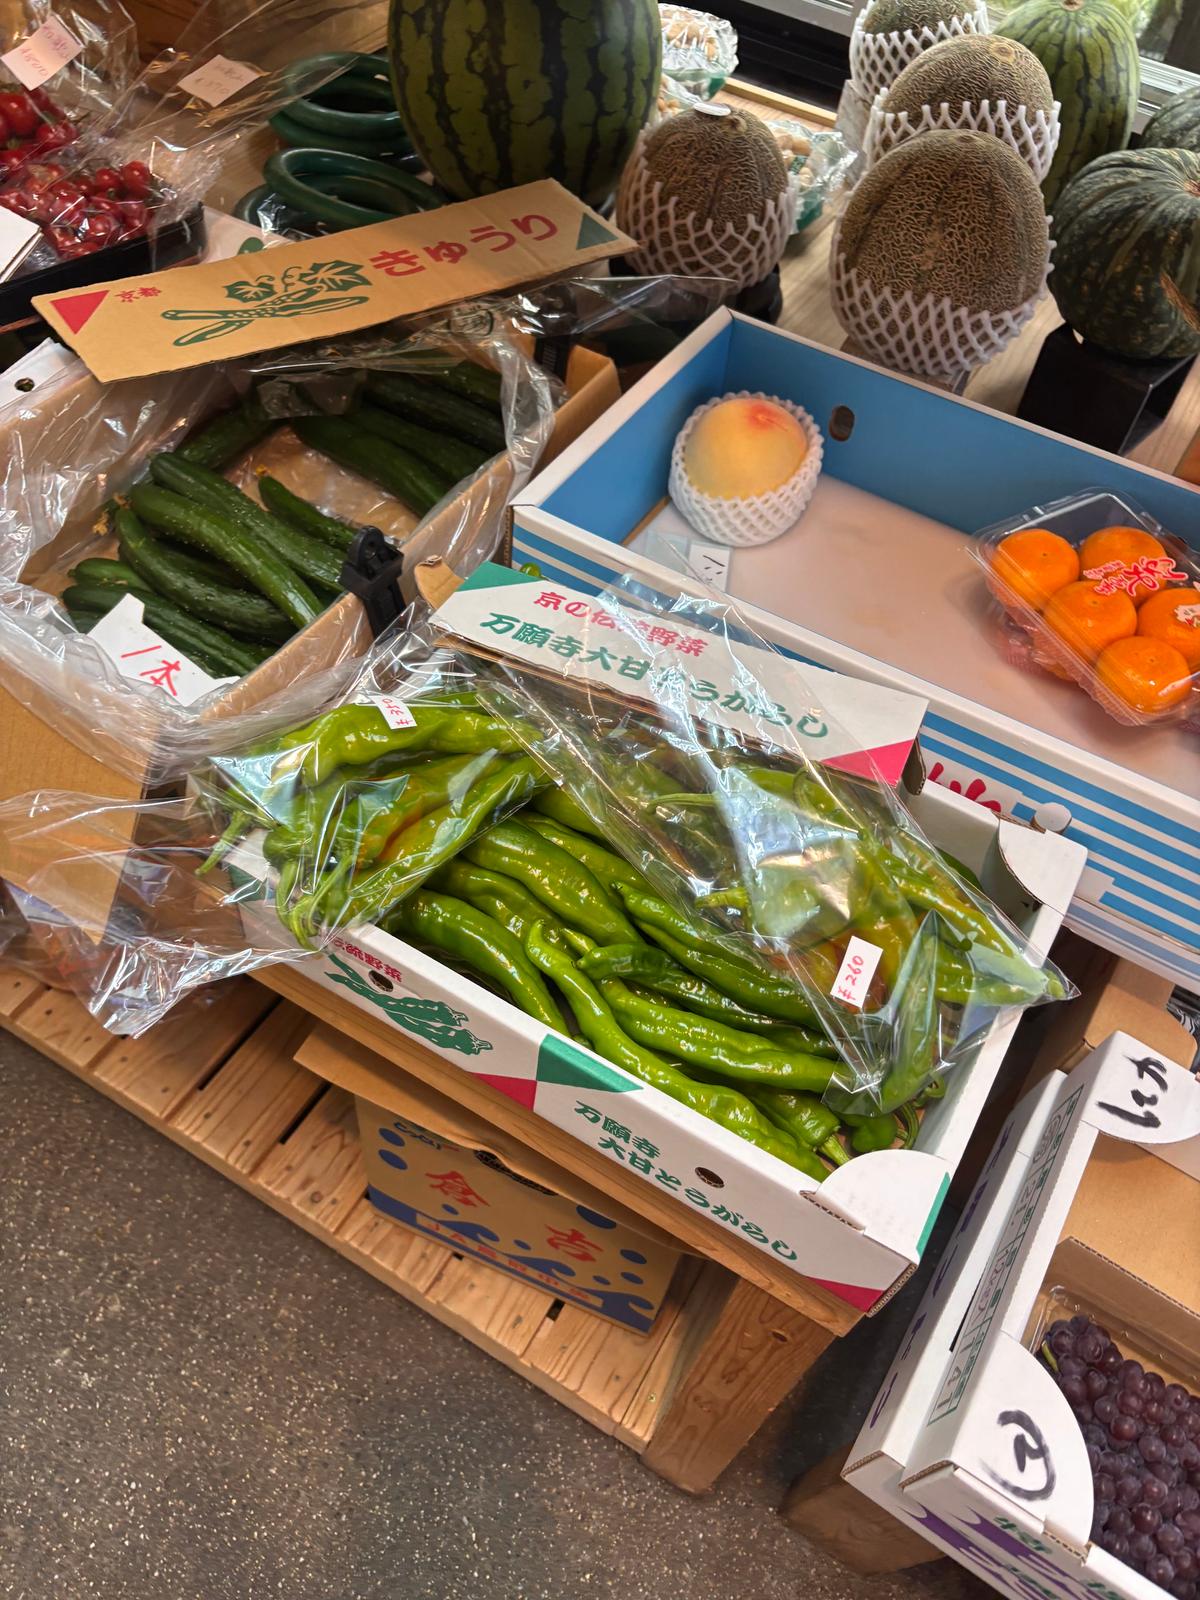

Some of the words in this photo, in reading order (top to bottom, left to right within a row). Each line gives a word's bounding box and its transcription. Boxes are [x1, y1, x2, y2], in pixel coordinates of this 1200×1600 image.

[370, 214, 558, 277] きゅうり
[534, 591, 708, 657] 京の伝野菜
[480, 612, 828, 738] 万願寺大甘うがらし
[838, 955, 864, 1001] ¥260
[575, 1100, 661, 1158] 万願寺
[598, 1136, 797, 1260] 大甘とうがらし
